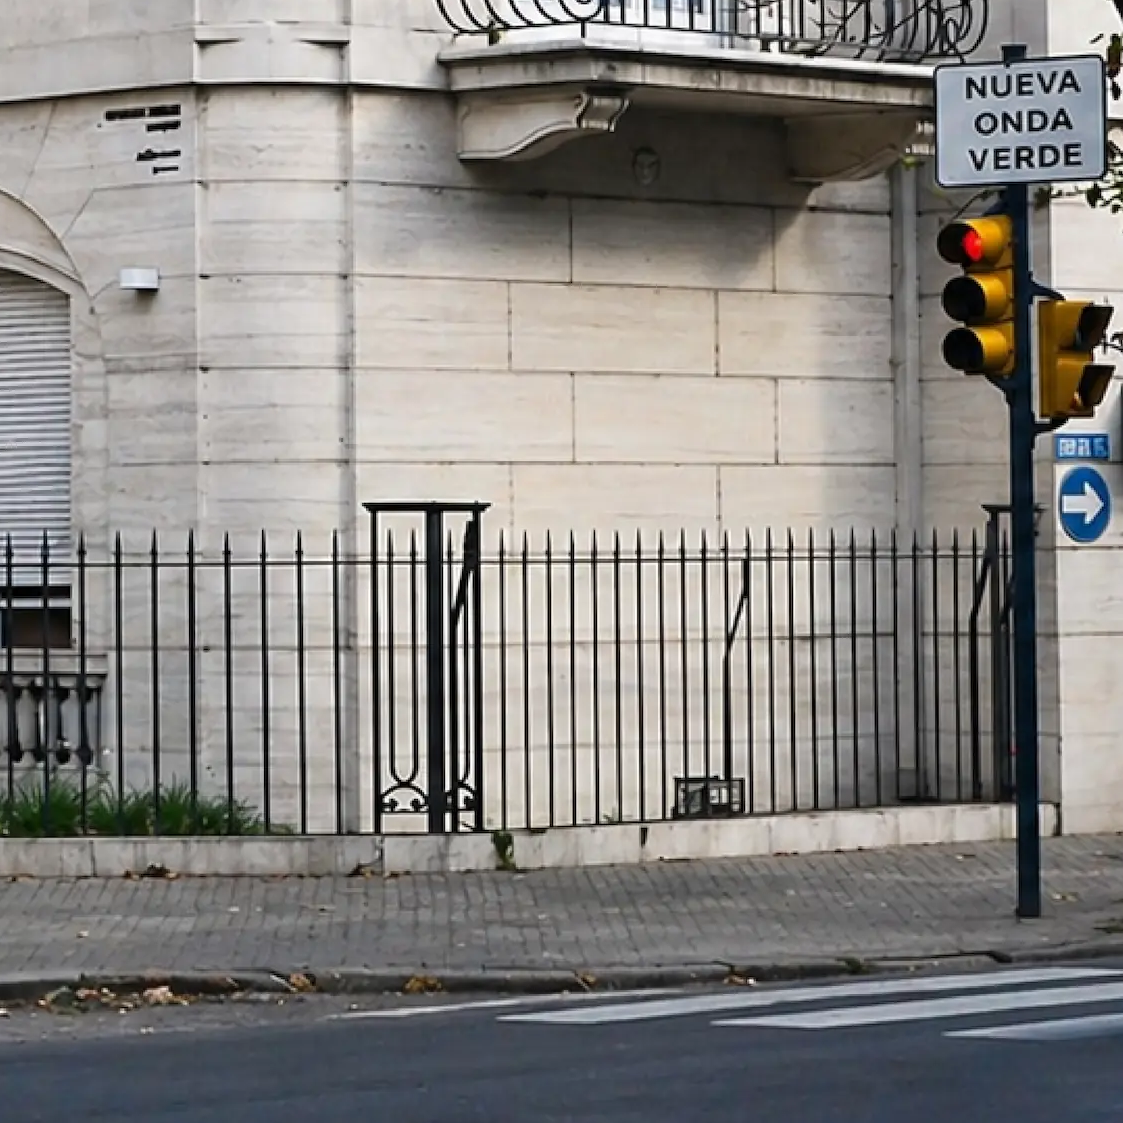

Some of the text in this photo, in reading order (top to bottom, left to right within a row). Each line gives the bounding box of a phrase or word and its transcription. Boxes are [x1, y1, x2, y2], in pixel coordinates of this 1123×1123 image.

[965, 69, 1082, 100] NUEVA
[974, 108, 1074, 135] ONDA
[967, 142, 1083, 171] VERDE
